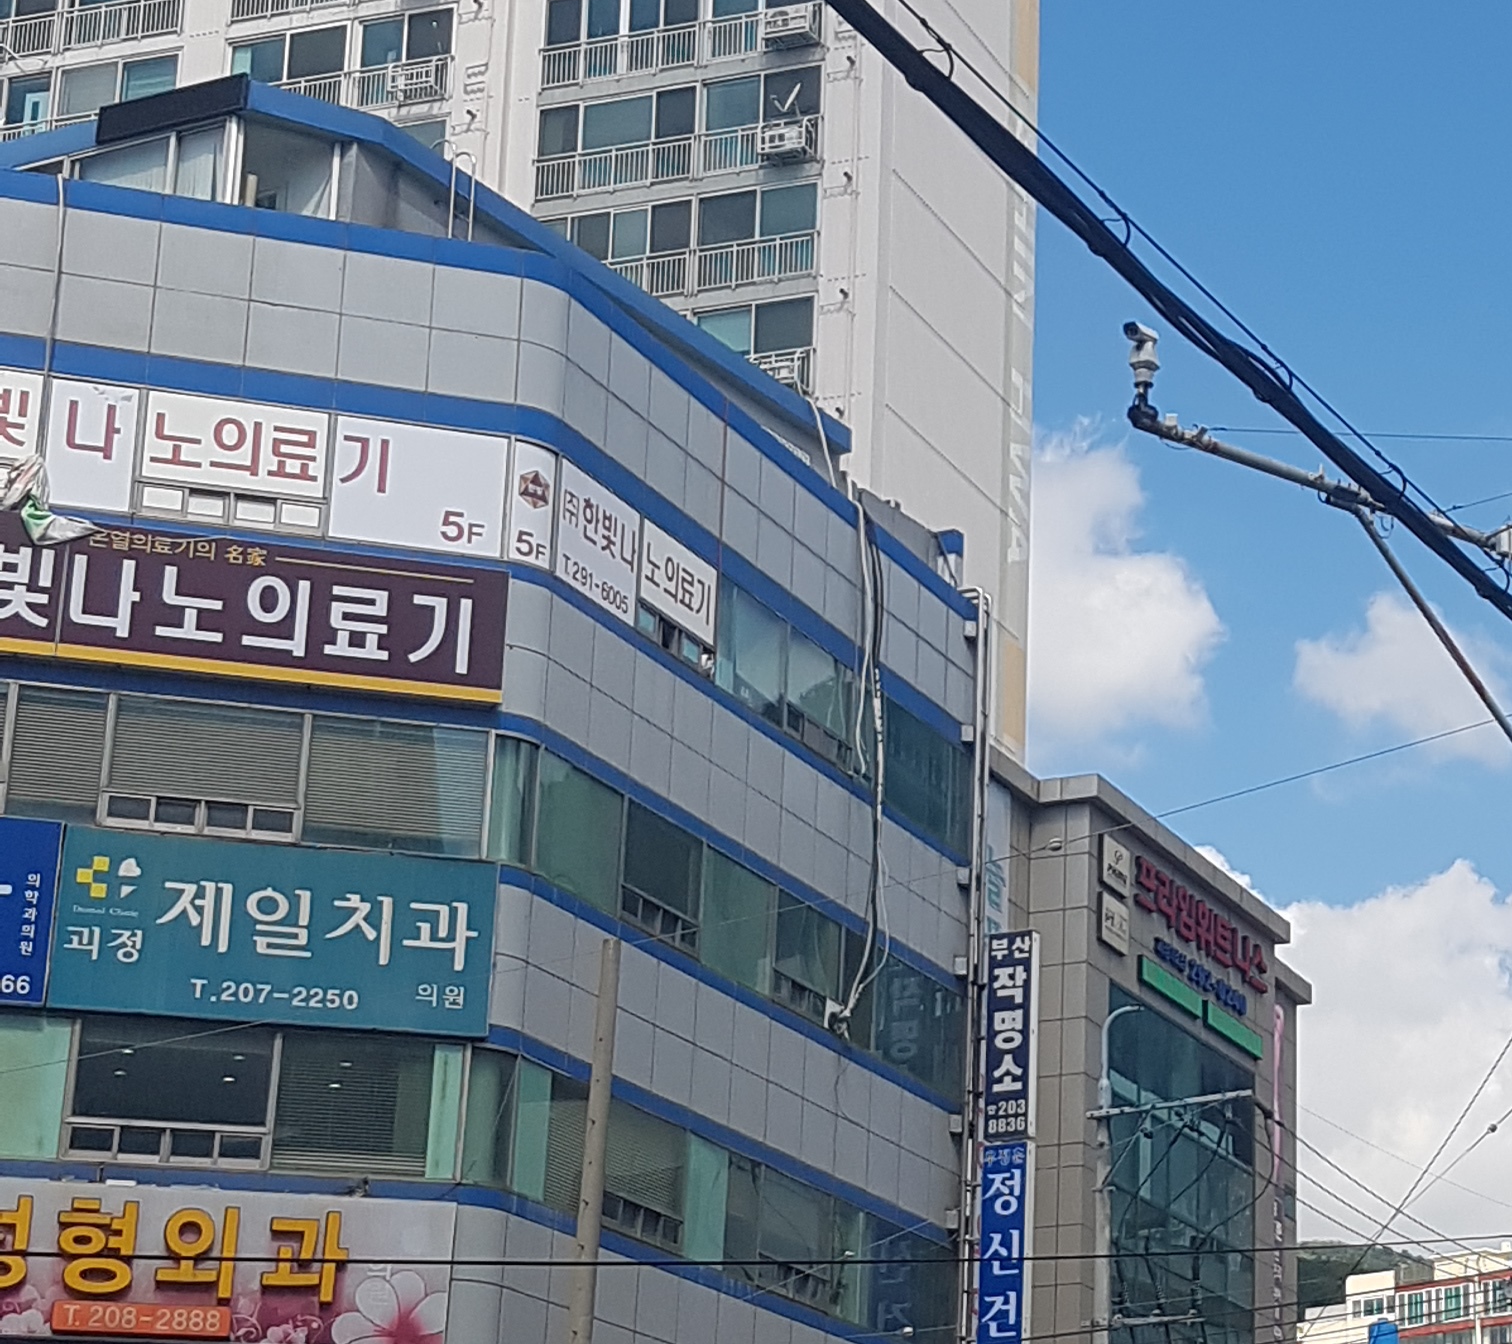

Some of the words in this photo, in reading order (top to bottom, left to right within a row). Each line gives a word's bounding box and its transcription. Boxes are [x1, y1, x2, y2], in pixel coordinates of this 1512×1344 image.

[439, 510, 486, 544] 5F
[515, 530, 547, 561] 5F
[562, 553, 629, 615] T.291-6005
[63, 926, 143, 963] 괴정
[155, 880, 478, 971] 제일치과
[991, 935, 1031, 960] 부산
[190, 978, 359, 1010] T.207-2250
[416, 982, 464, 1009] 의원
[992, 965, 1028, 1093] 작명소
[998, 1099, 1026, 1115] 203
[63, 1304, 80, 1327] T.
[89, 1305, 220, 1333] 208-2888
